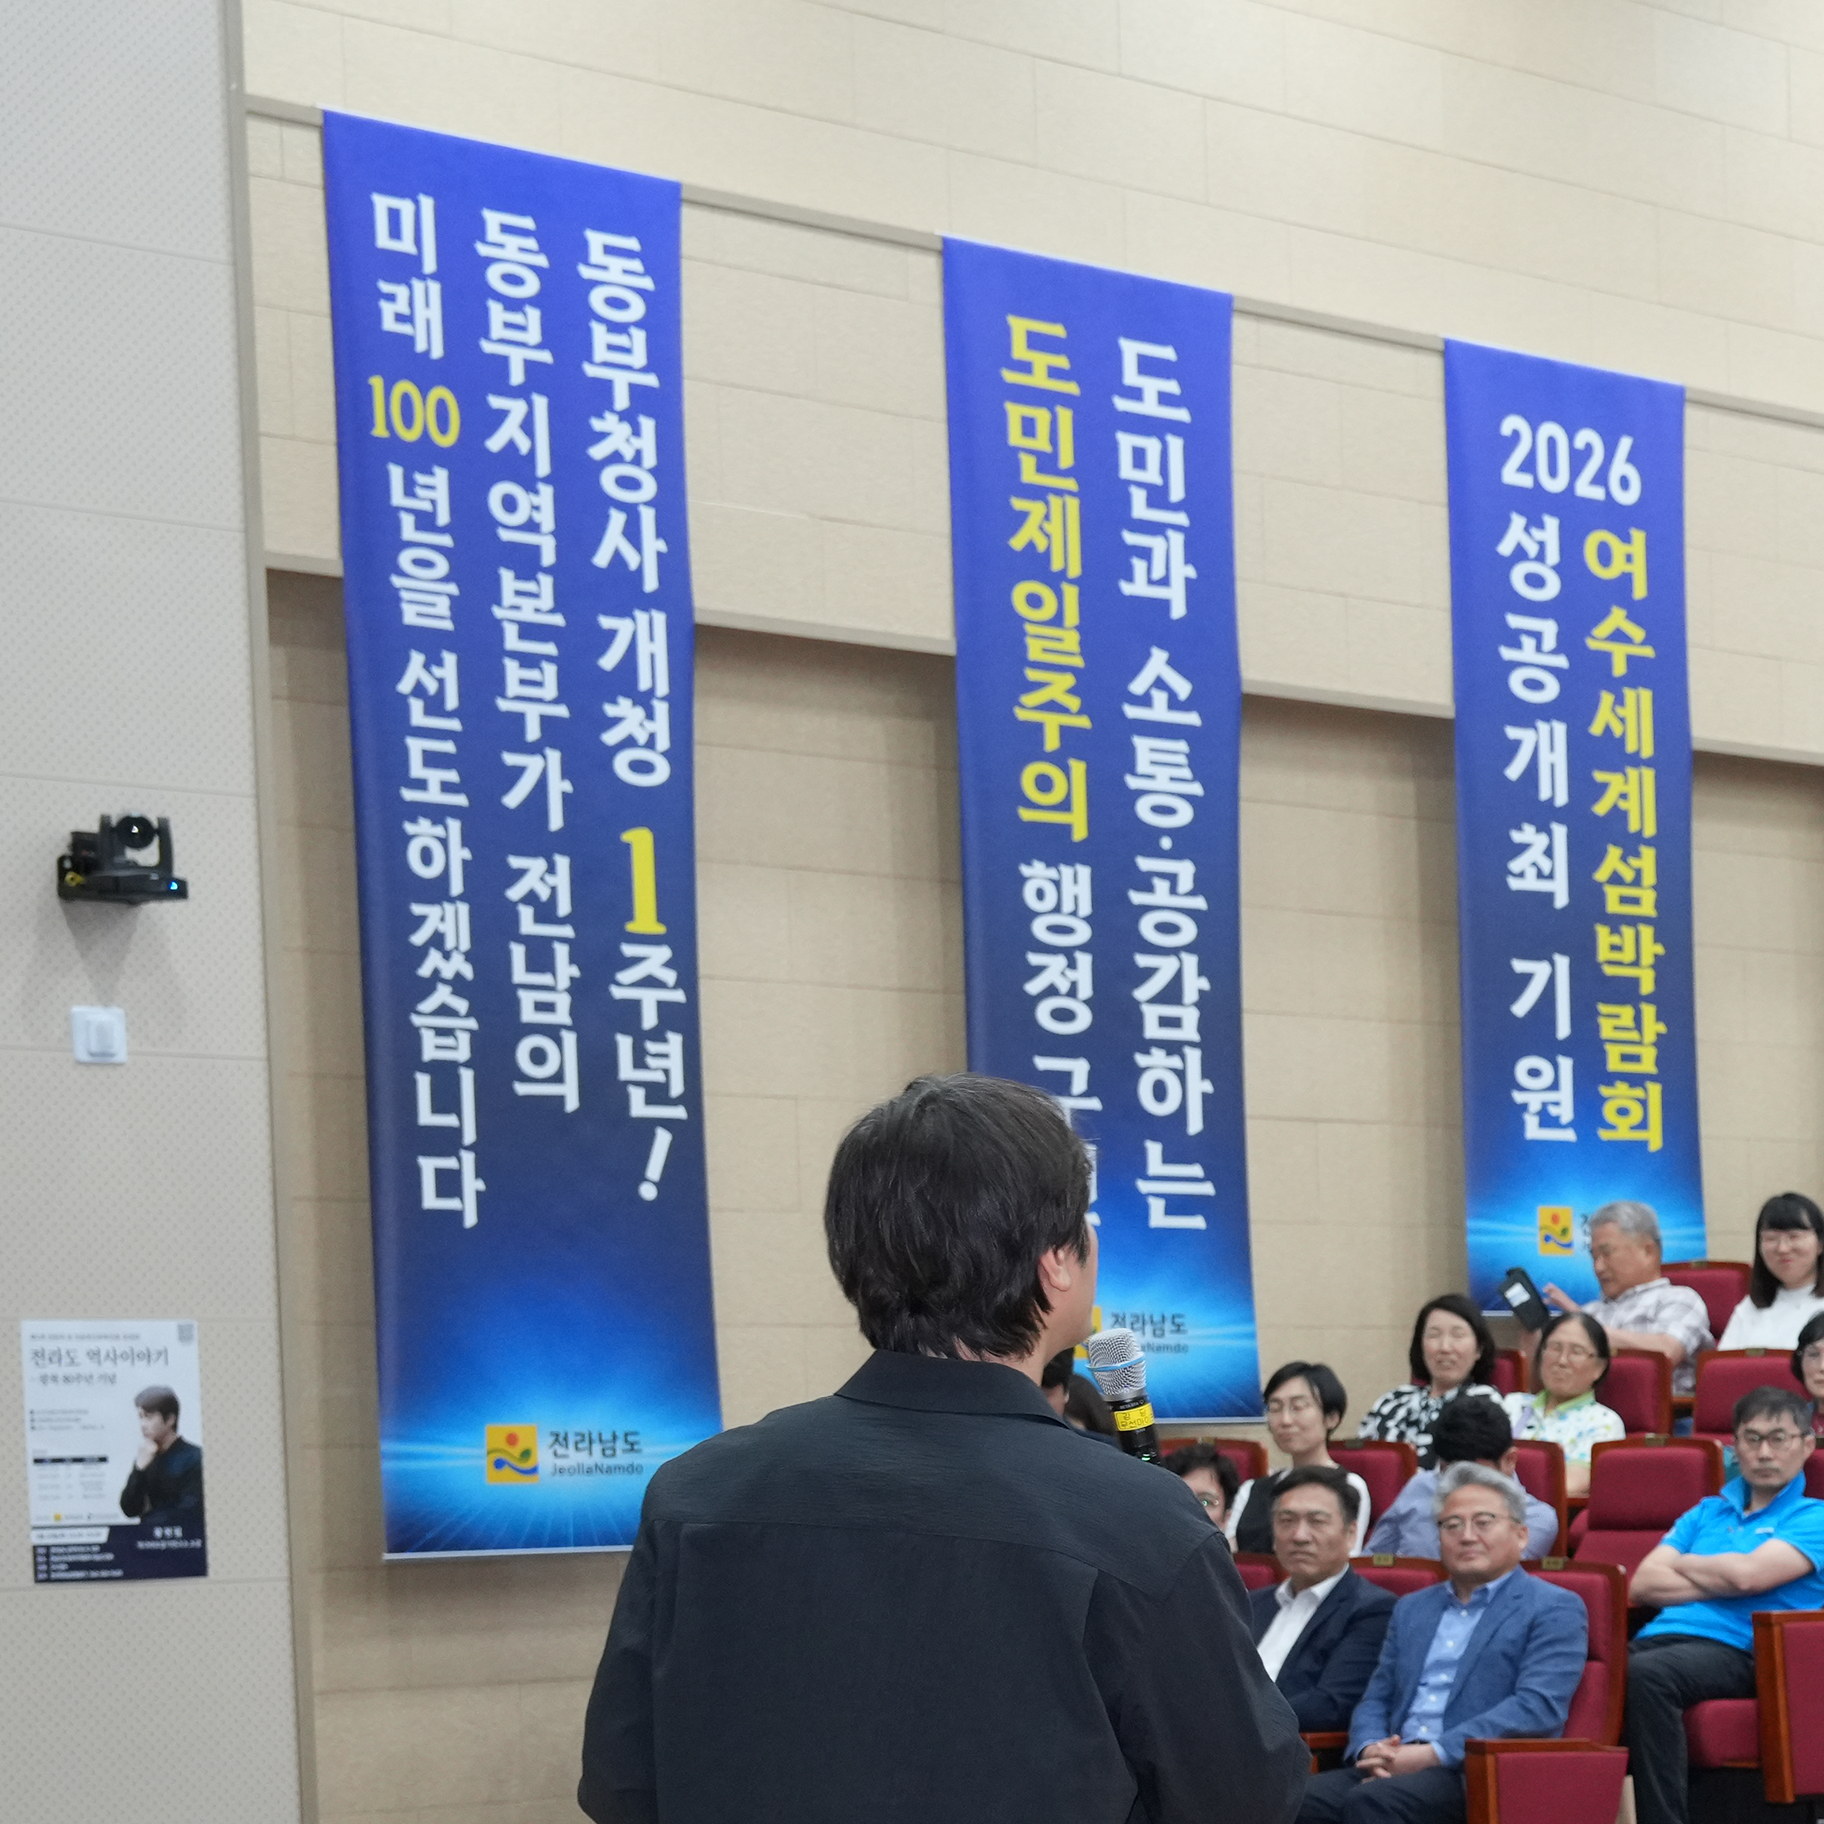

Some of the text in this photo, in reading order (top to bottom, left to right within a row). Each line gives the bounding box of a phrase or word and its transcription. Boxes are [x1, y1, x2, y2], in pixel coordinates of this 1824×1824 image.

[371, 193, 444, 359] 미래
[577, 229, 668, 593] 동부청사
[1000, 314, 1092, 842] 도민제일주의
[1112, 337, 1197, 620] 도민과
[1500, 414, 1641, 506] 2026
[474, 208, 580, 1113] 동부지역본부가 전남의
[597, 609, 670, 787] 개청
[397, 650, 486, 1228] 선도하겠습니다
[1019, 860, 1093, 1034] 행정
[1496, 512, 1576, 1142] 성공개최 기원
[1583, 527, 1667, 1152] 여수세계섬박람회
[550, 1430, 643, 1459] 전라남도
